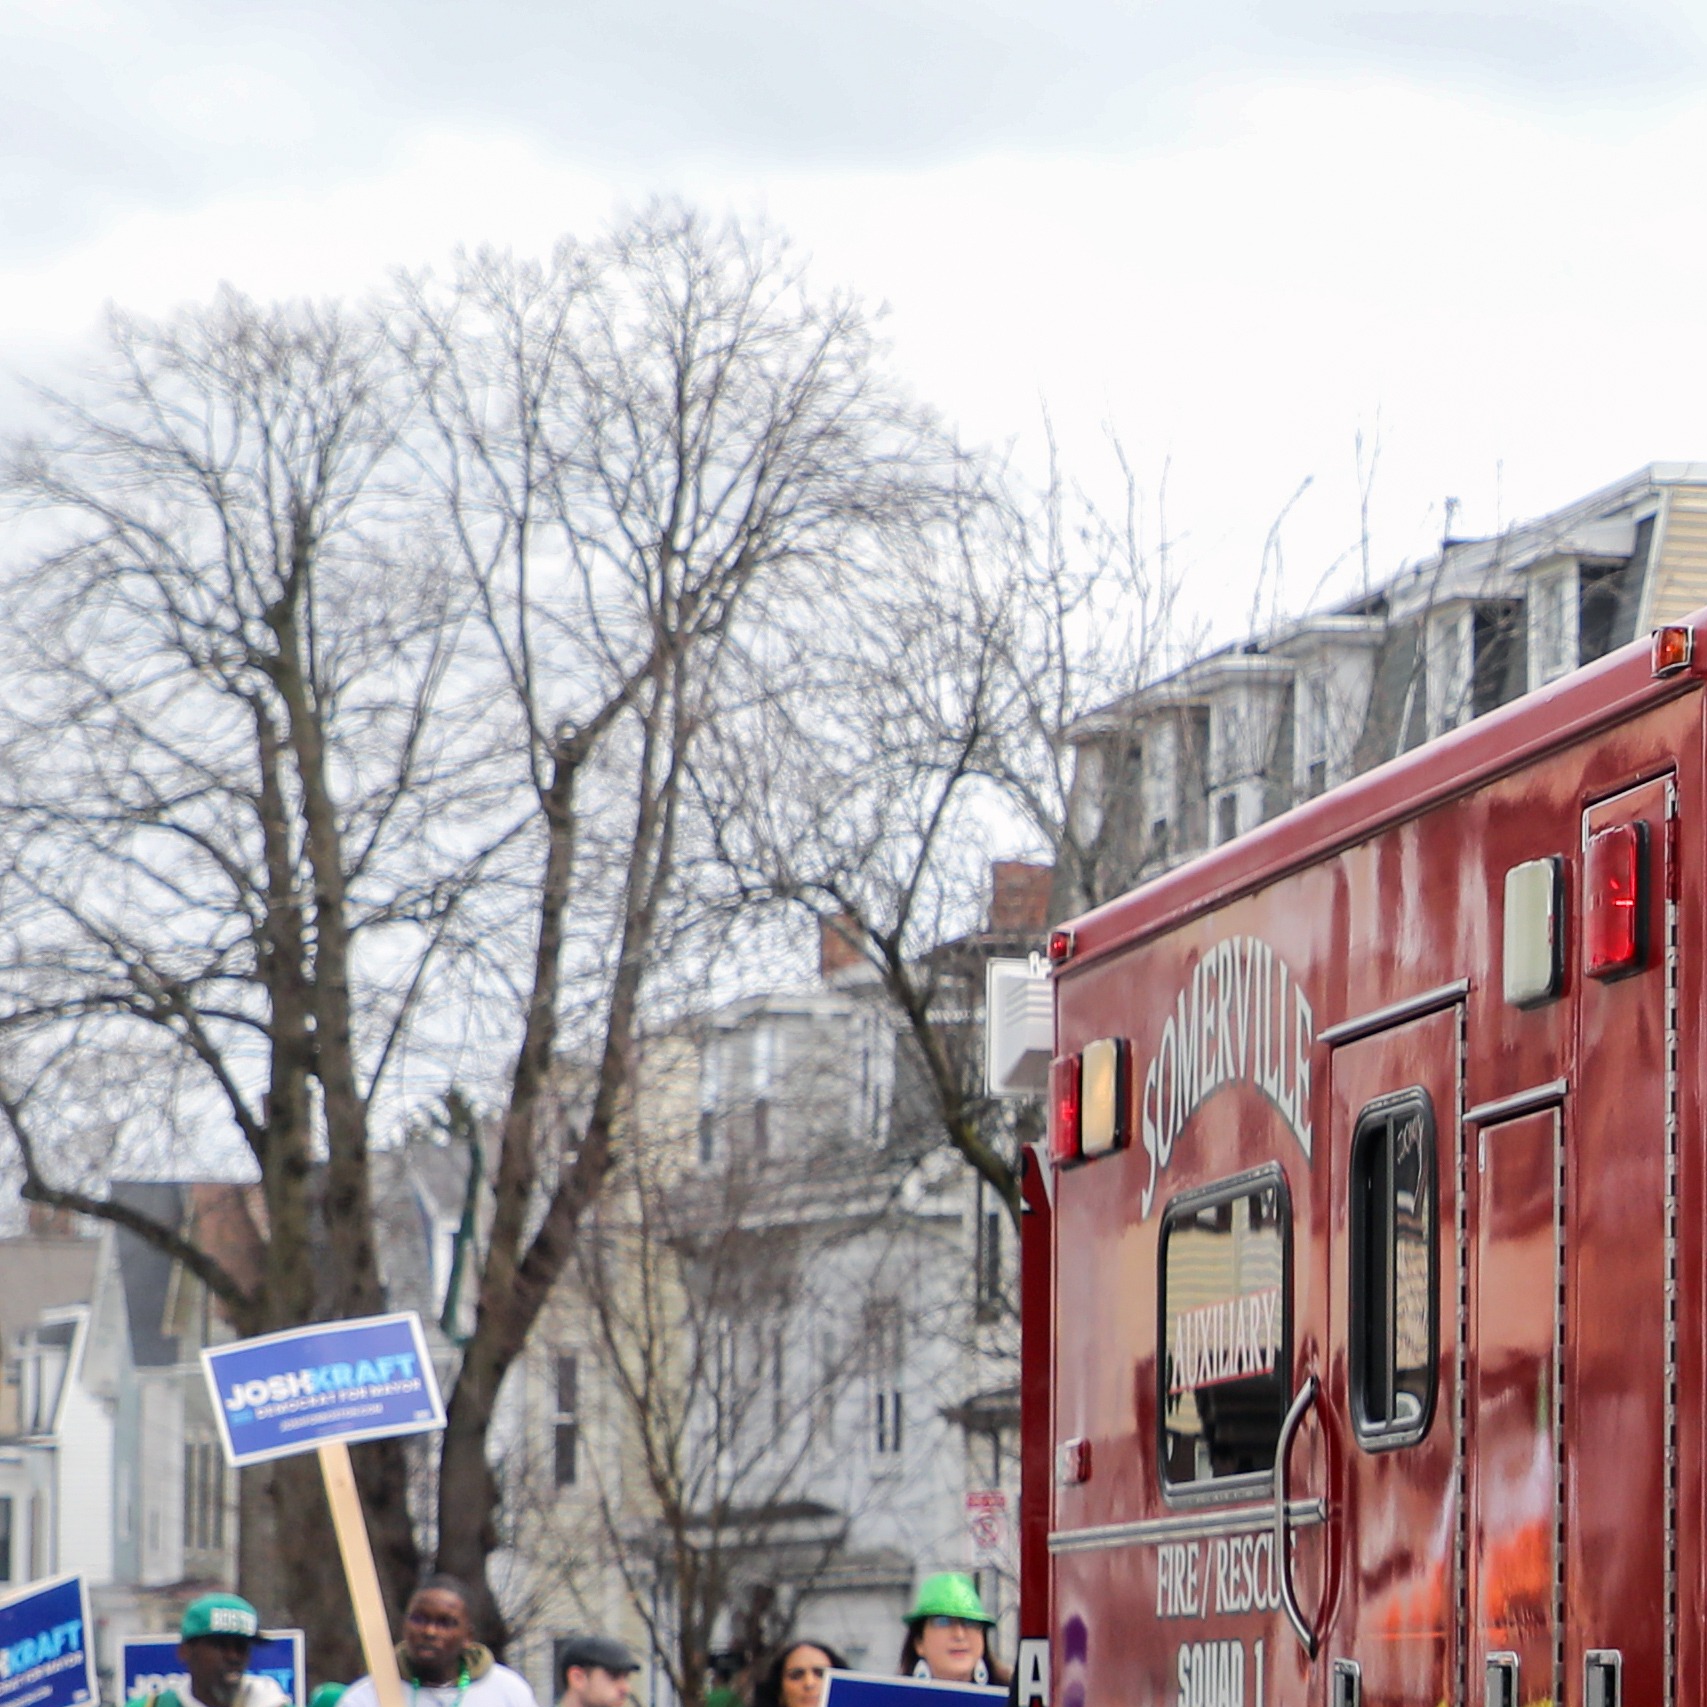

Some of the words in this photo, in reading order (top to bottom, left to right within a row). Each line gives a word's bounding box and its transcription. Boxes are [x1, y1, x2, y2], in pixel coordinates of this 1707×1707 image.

[1142, 935, 1313, 1221] SOMERVILLE
[225, 1352, 417, 1412] JOSHKRAFT
[1170, 1288, 1278, 1391] AUXILIARY
